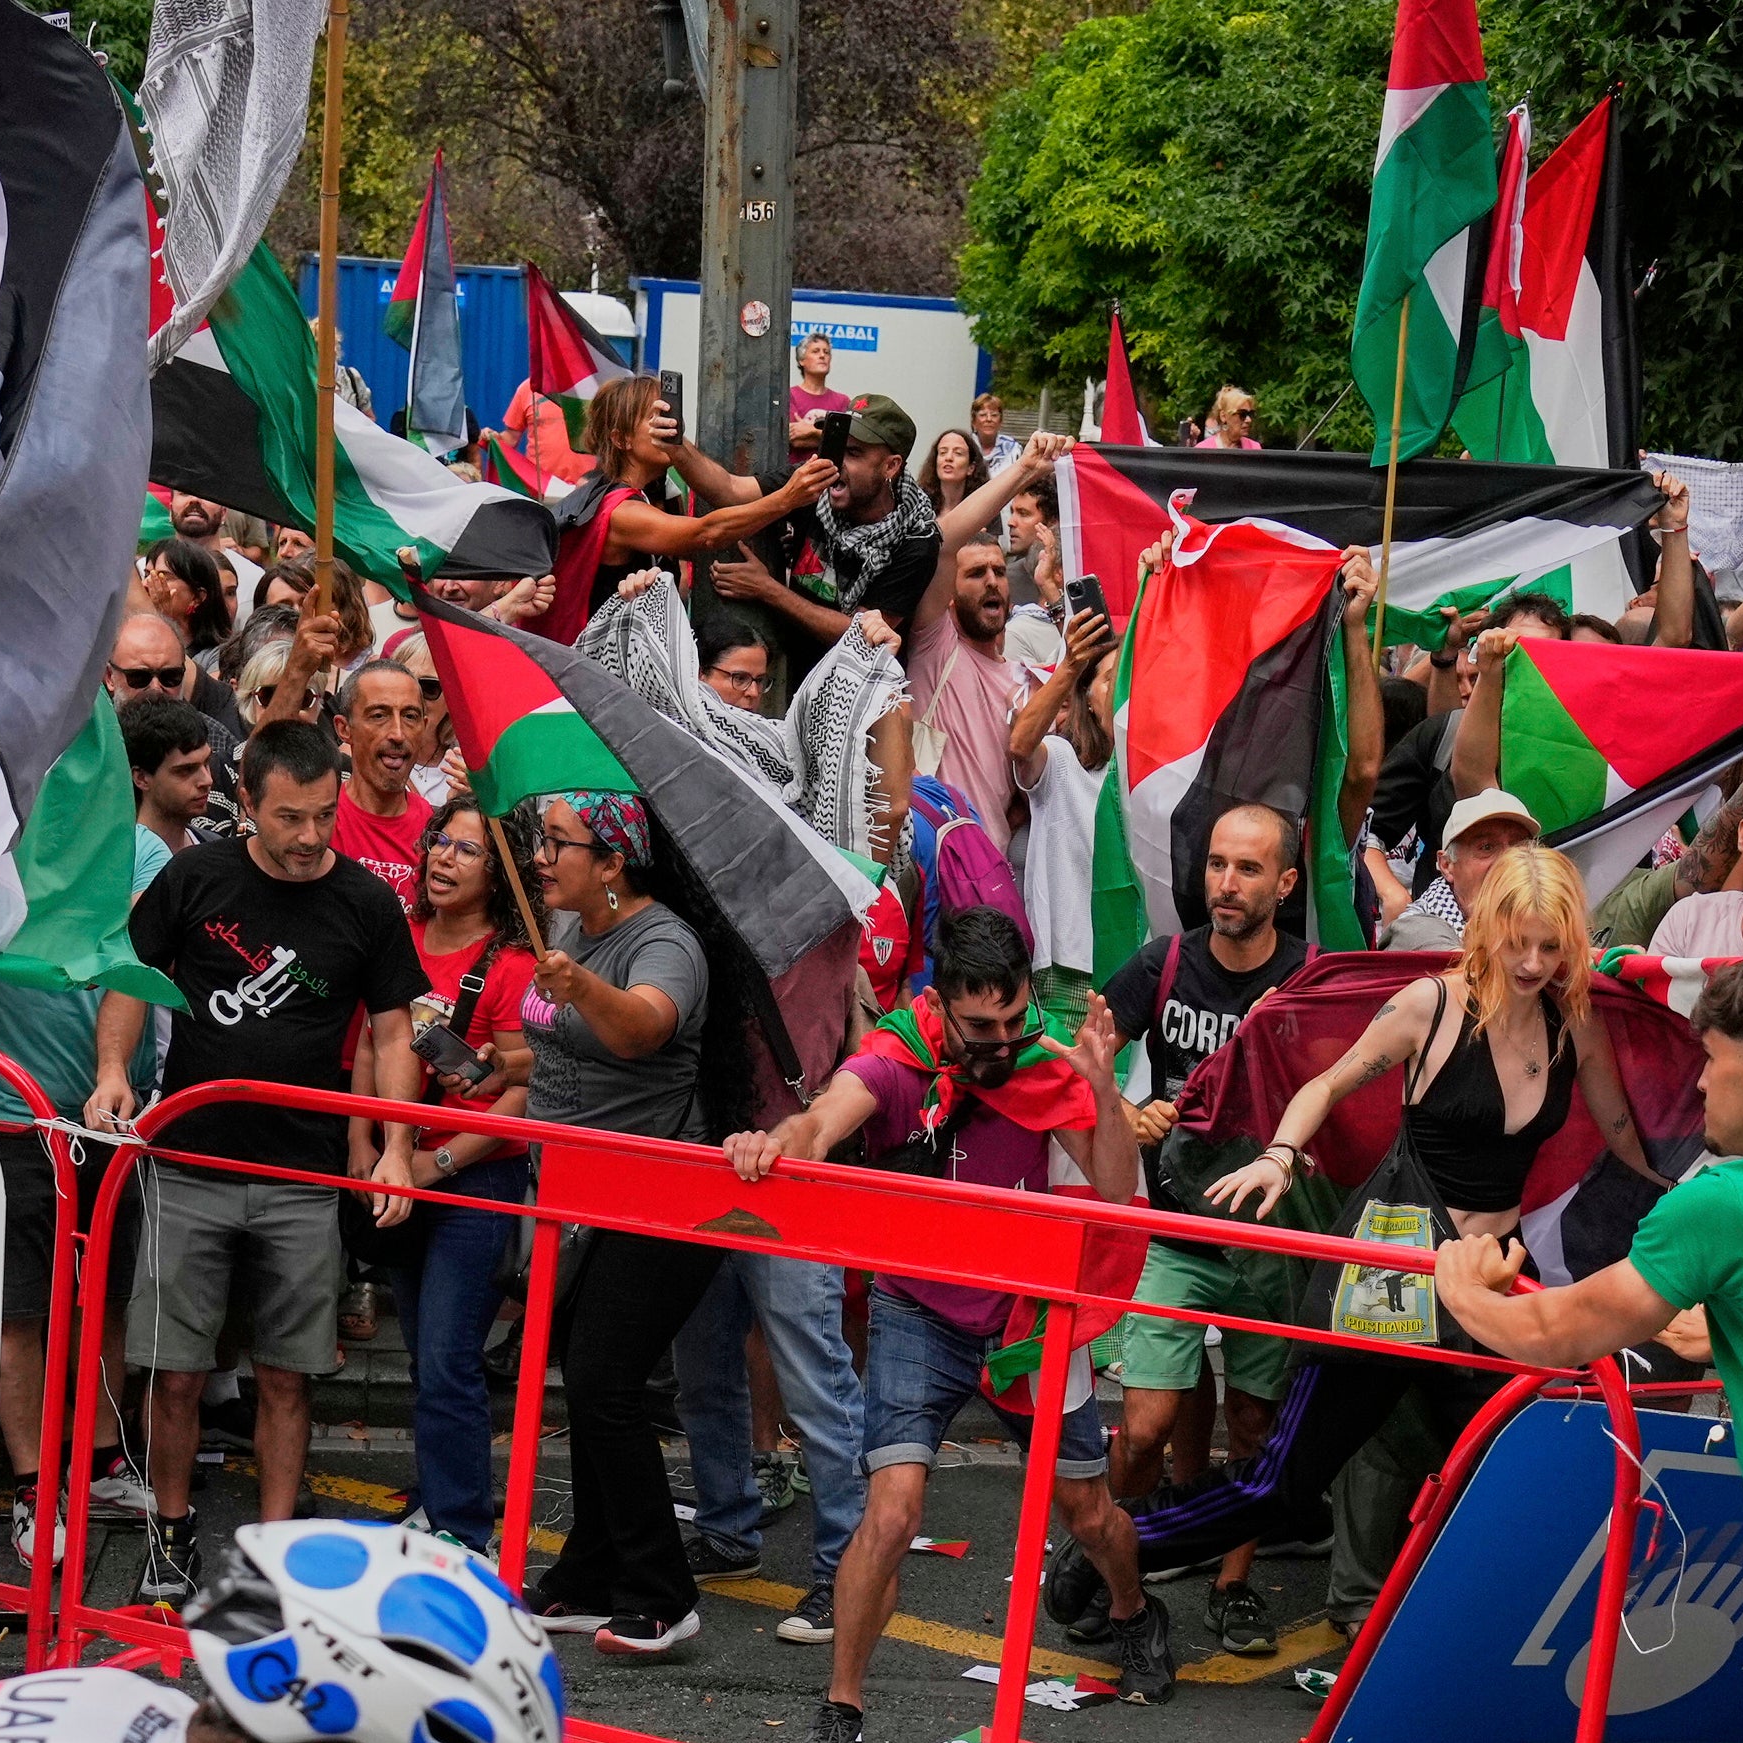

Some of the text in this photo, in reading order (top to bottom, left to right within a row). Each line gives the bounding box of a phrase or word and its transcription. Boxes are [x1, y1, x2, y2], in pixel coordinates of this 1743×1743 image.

[742, 202, 774, 221] 156
[791, 322, 876, 341] ALKIZABAL
[1345, 1316, 1421, 1334] POSITANO
[301, 1617, 384, 1680] MET
